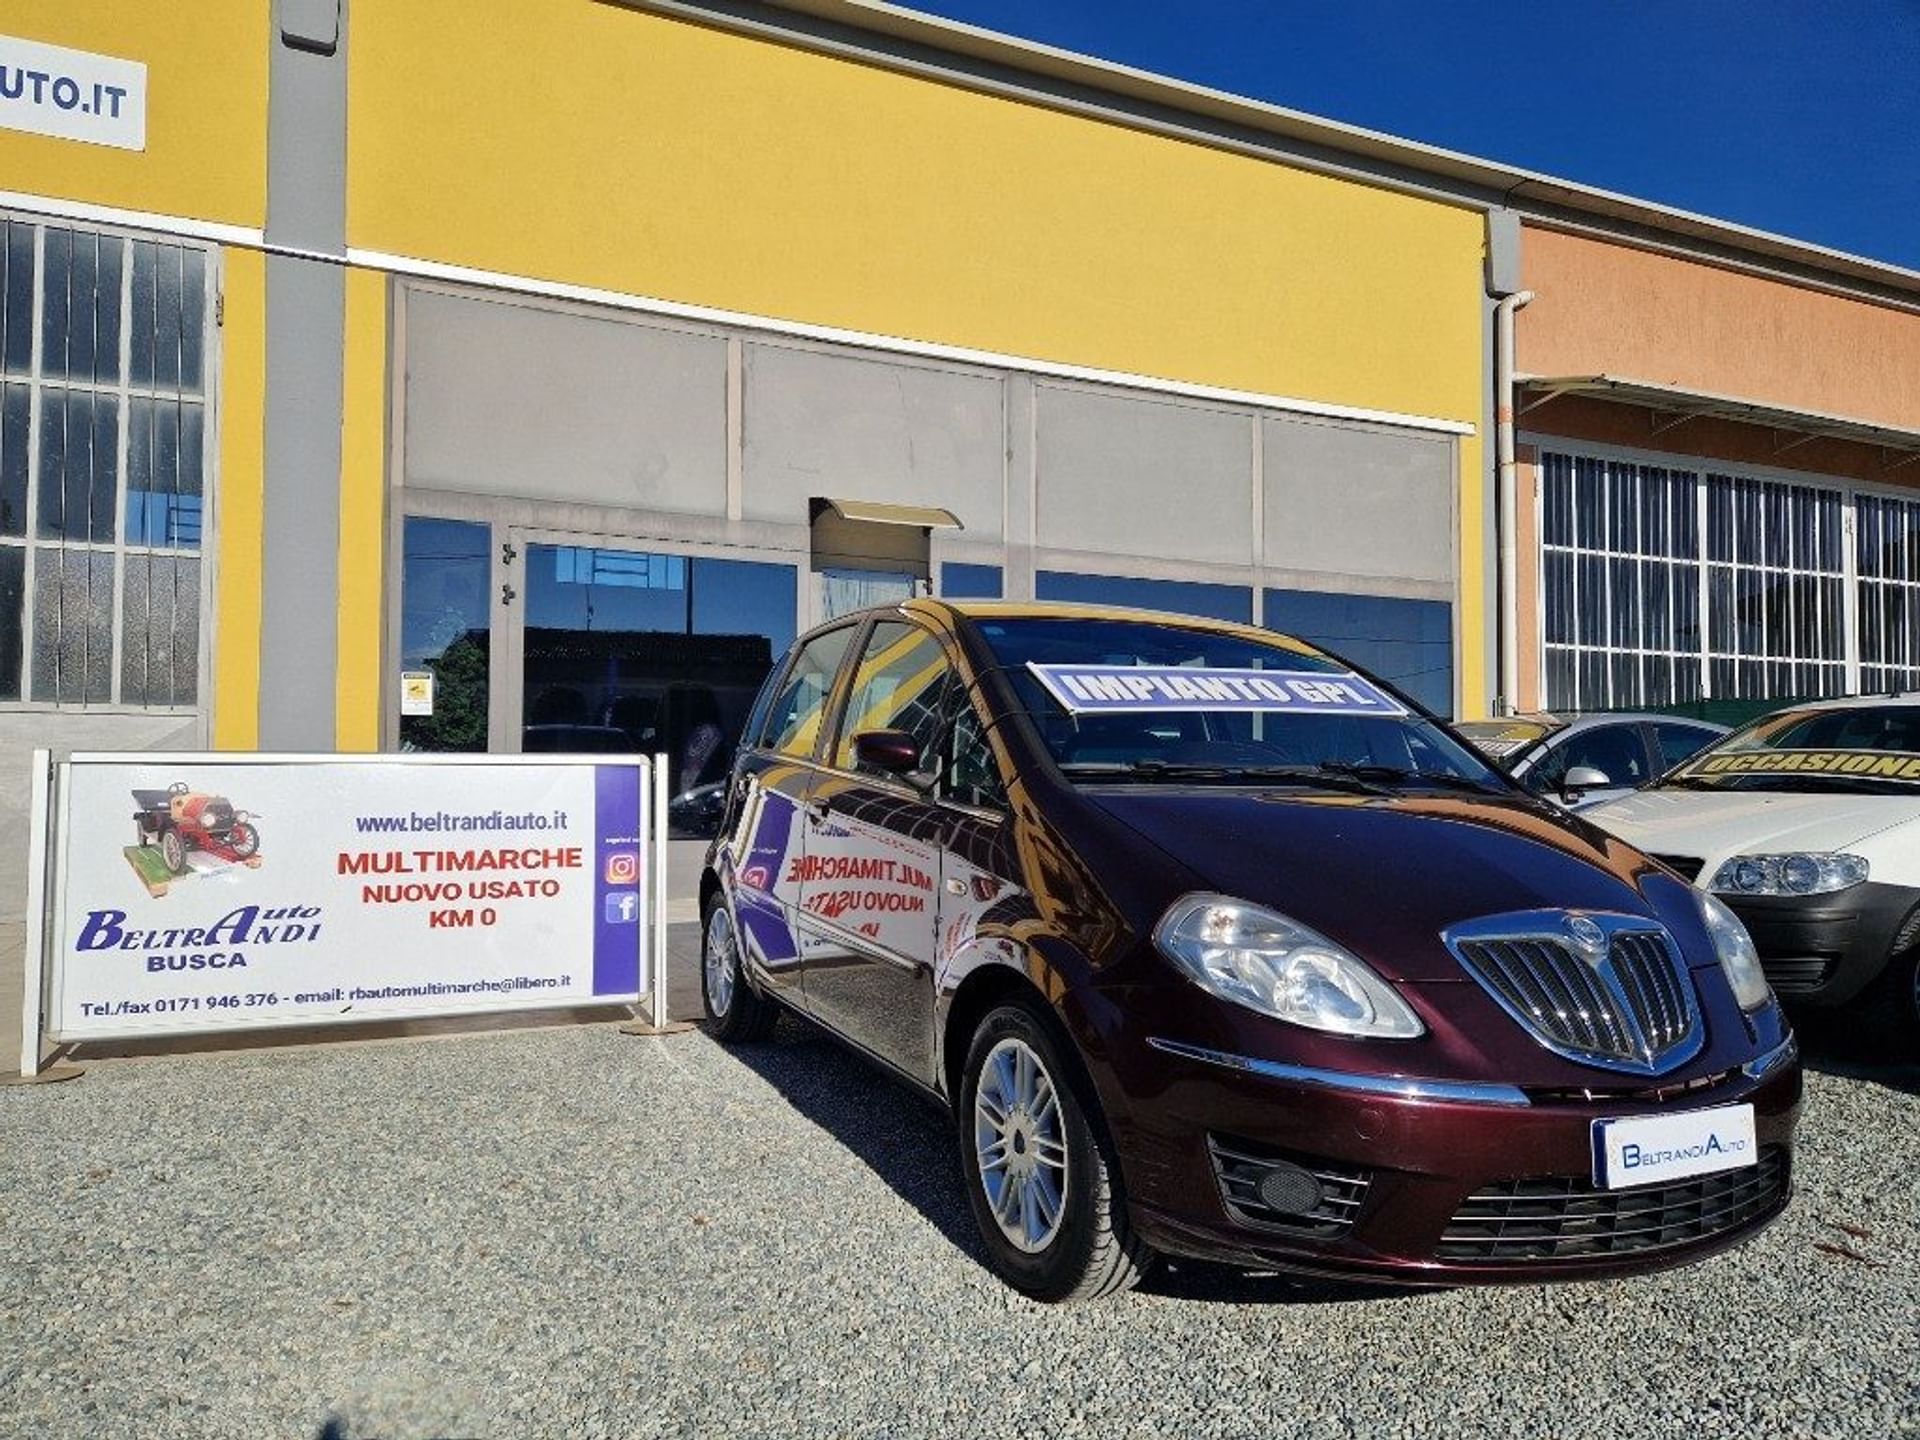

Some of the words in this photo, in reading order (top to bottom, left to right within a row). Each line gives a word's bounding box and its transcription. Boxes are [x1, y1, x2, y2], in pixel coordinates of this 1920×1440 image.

[1059, 674, 1291, 701] IMPIANTO
[1284, 679, 1378, 705] GPL
[356, 810, 568, 832] www.beltrandiauto.it
[337, 847, 583, 875] MULTIMARCHE
[362, 882, 462, 903] NUOVO
[468, 879, 560, 899] USATO
[429, 909, 474, 928] KM
[480, 907, 496, 926] 0
[147, 952, 248, 972] BUSCA
[81, 1001, 150, 1017] Tel./fax
[155, 999, 200, 1013] 0171
[206, 995, 240, 1009] 946
[245, 992, 278, 1006] 376
[294, 988, 344, 1004] email:
[349, 974, 571, 1001] rbautomultimarche@libero.it
